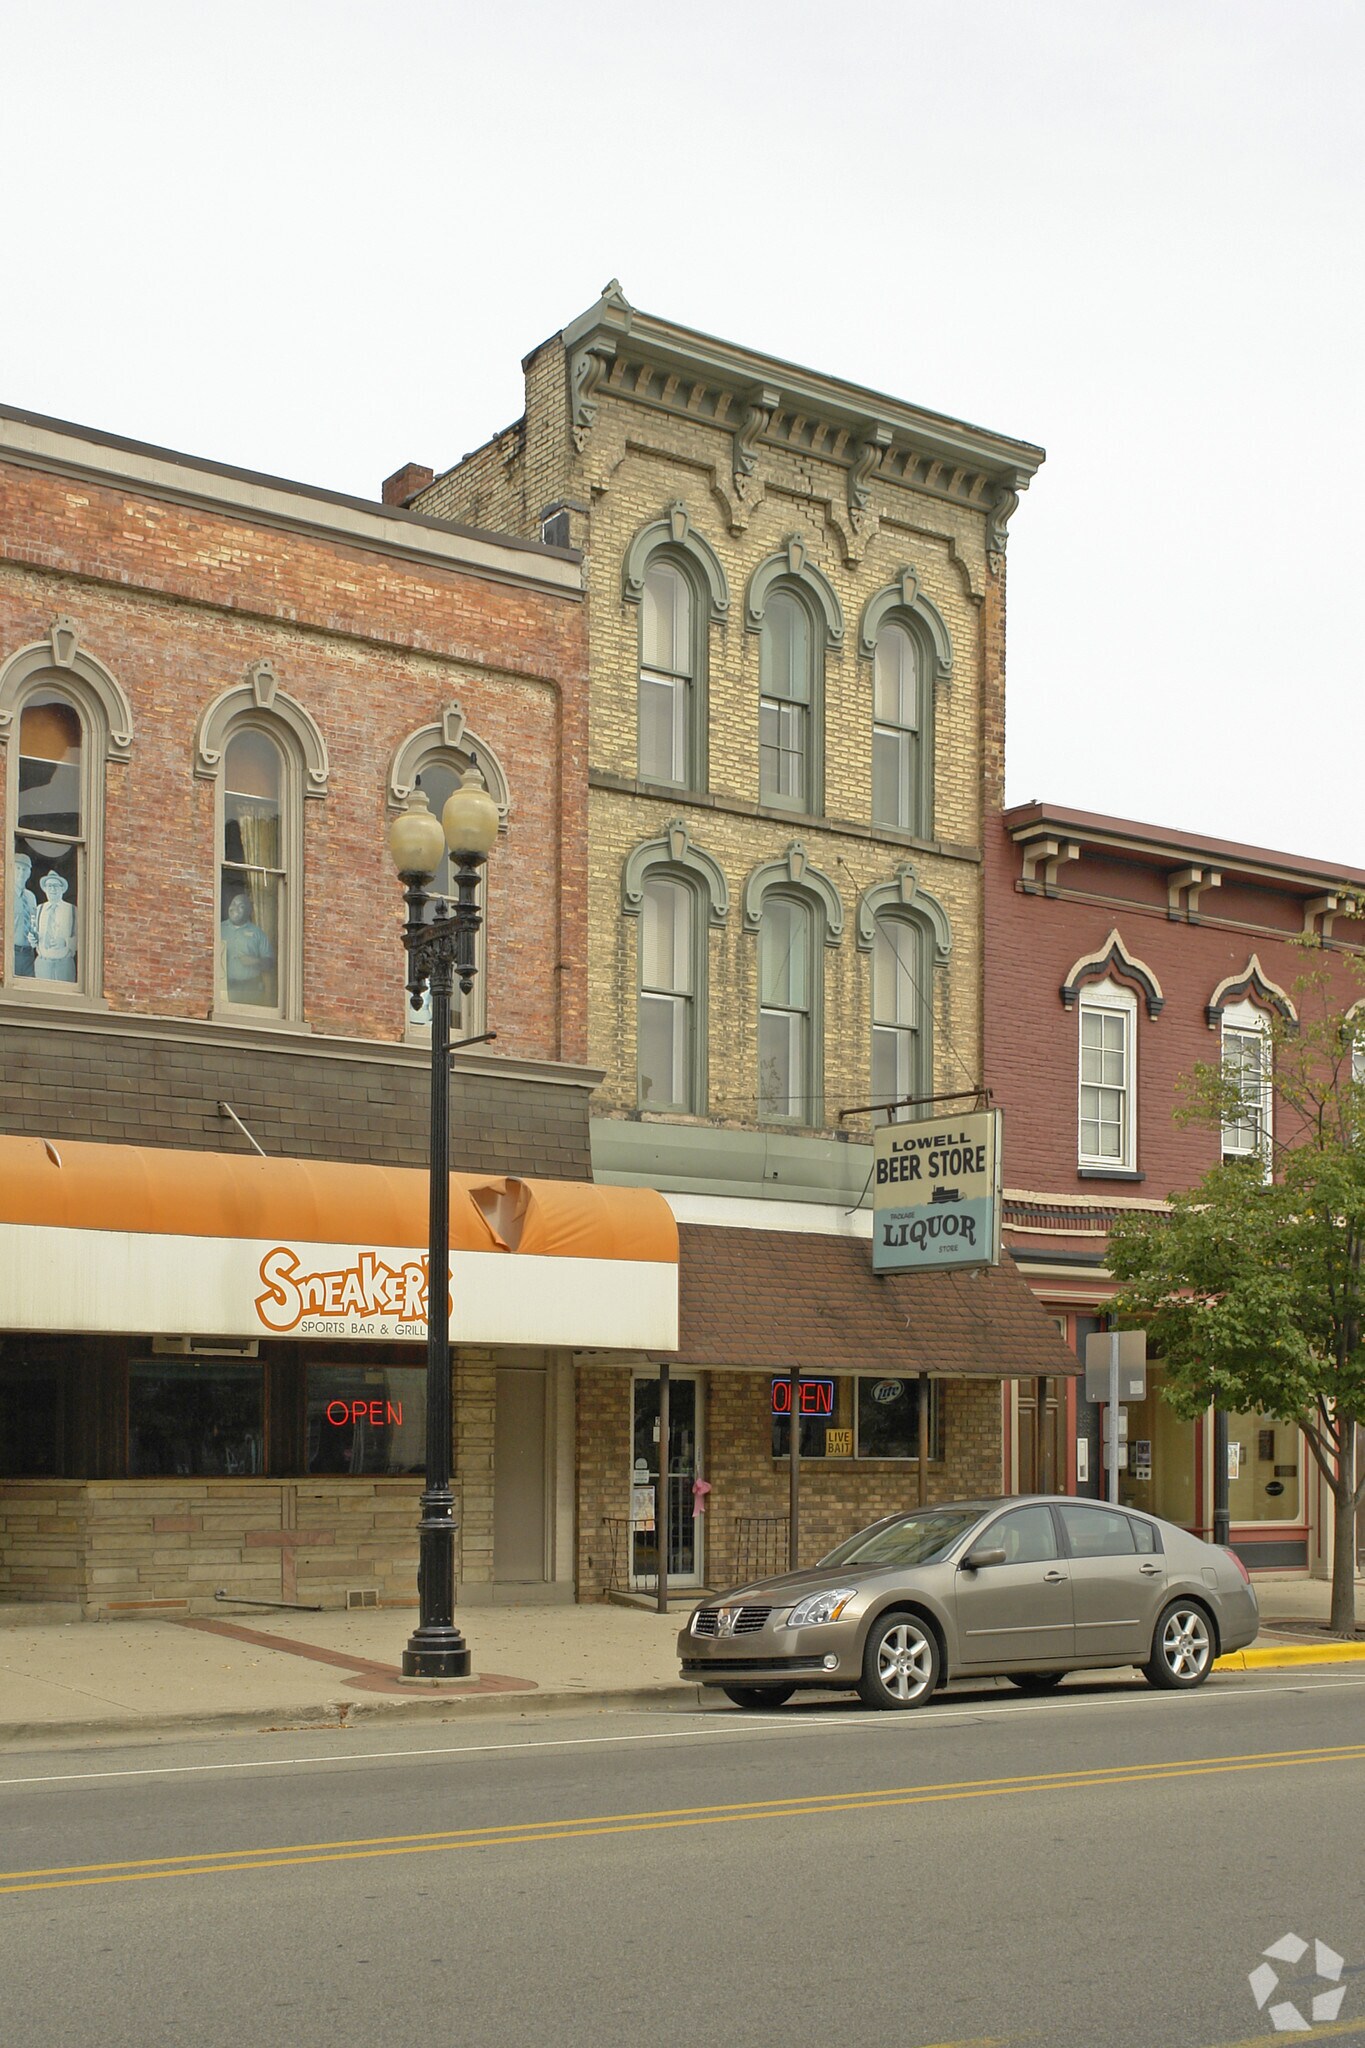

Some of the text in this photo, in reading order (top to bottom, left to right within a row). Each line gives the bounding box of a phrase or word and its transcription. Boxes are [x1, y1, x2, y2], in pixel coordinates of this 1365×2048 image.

[892, 1133, 971, 1152] LOWELL
[876, 1145, 986, 1185] BEER STORE
[883, 1214, 976, 1251] LIQUOR
[938, 1244, 959, 1253] STORE
[301, 1321, 426, 1336] SPORTS BAR & GRILL
[327, 1400, 403, 1426] OPEN
[828, 1431, 850, 1442] LIVE
[828, 1443, 850, 1453] BAIT
